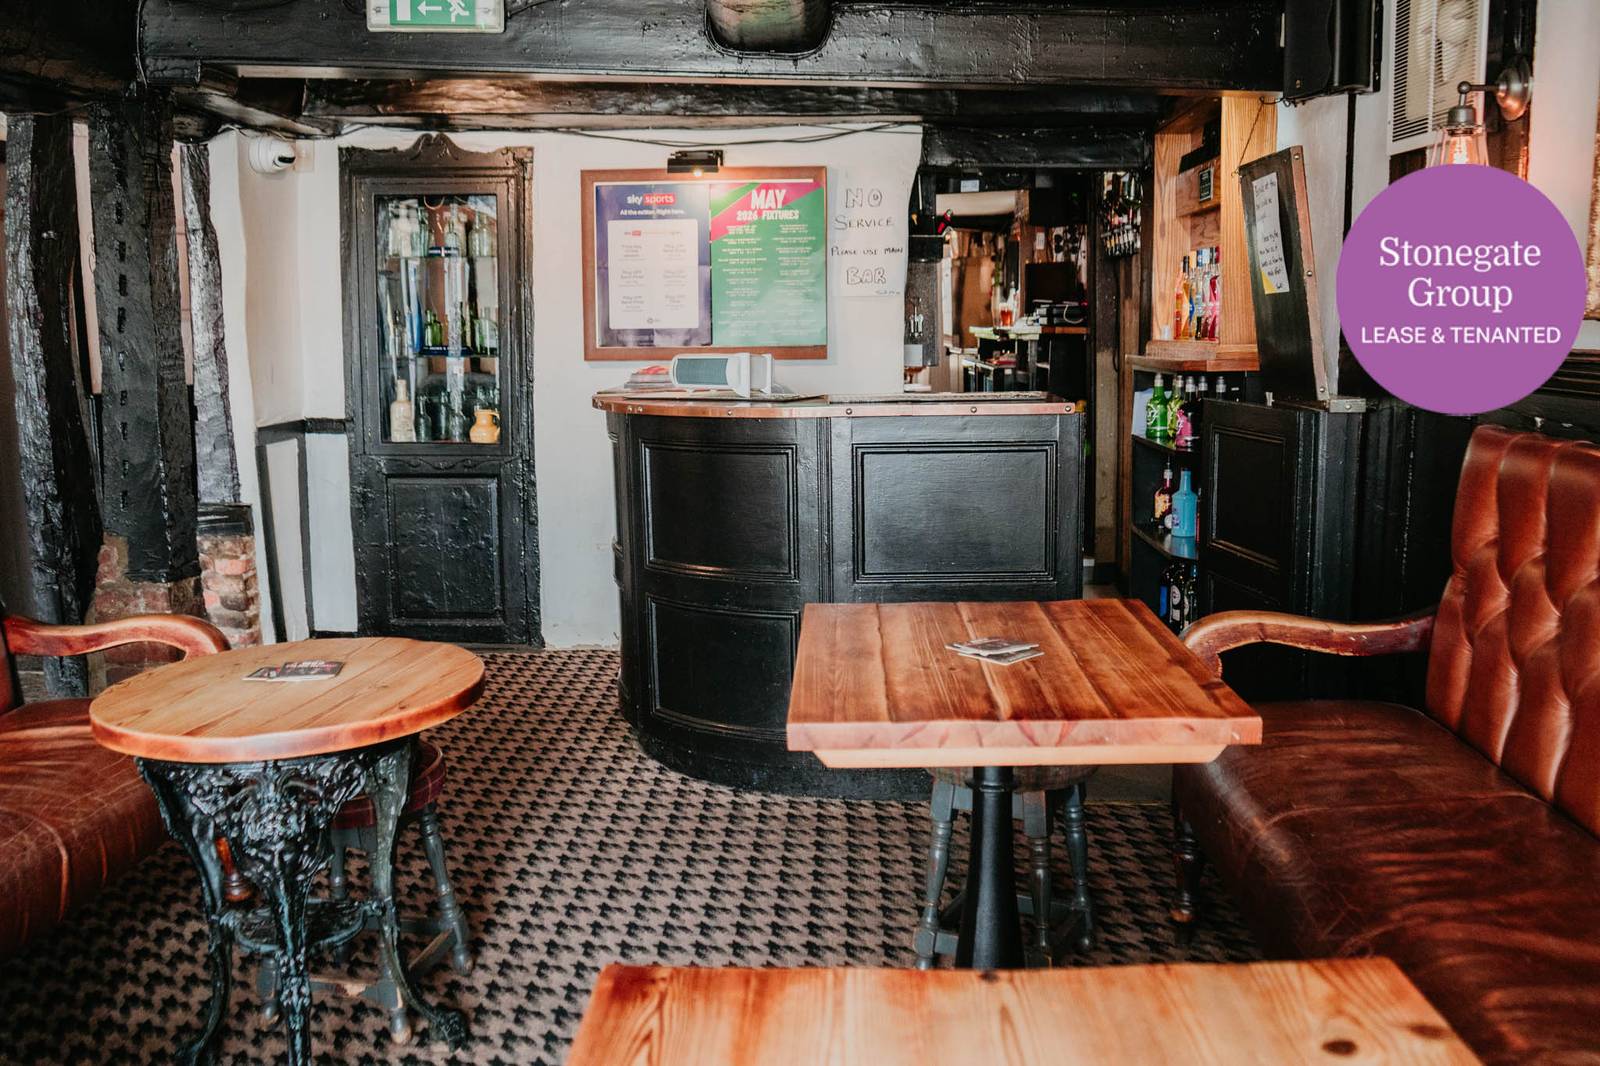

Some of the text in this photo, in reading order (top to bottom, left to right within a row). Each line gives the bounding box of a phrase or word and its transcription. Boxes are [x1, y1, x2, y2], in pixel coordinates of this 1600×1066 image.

[626, 194, 675, 206] sky sports
[751, 188, 787, 209] MAY
[845, 187, 883, 209] NO
[736, 209, 800, 221] 2026 FIXTURES
[846, 266, 887, 286] BAR
